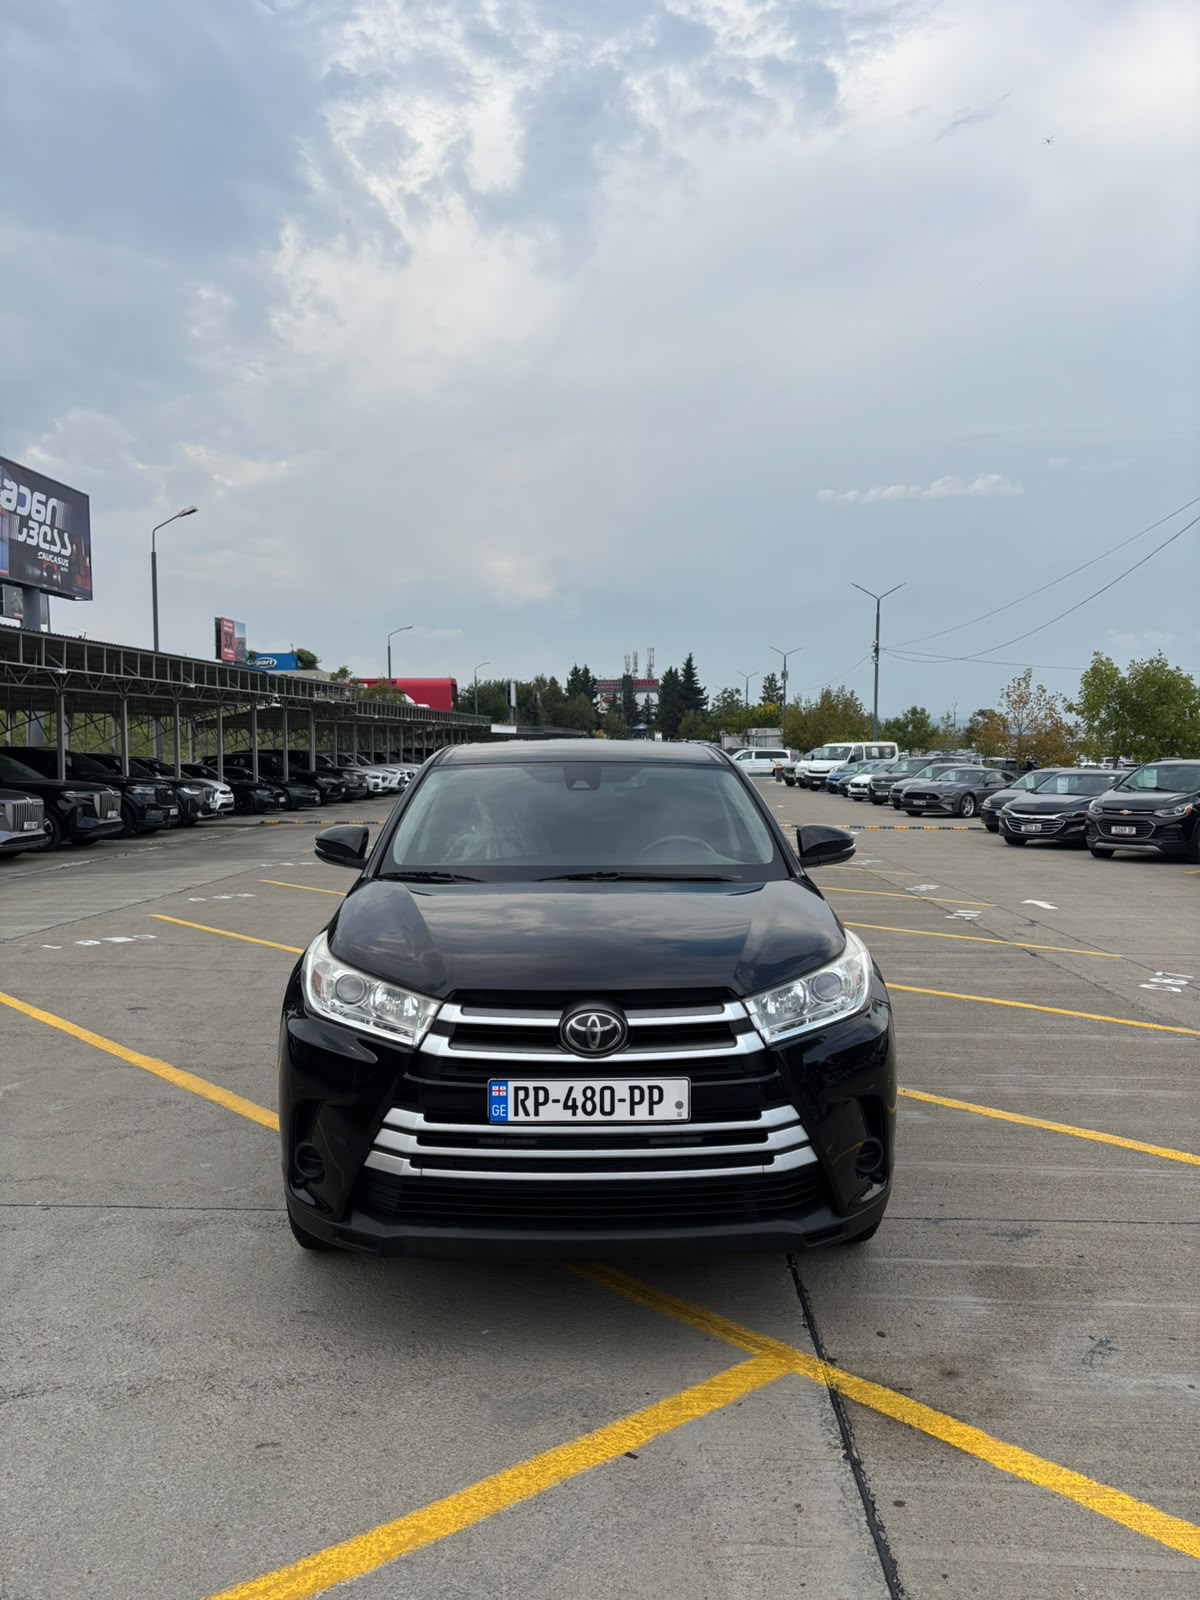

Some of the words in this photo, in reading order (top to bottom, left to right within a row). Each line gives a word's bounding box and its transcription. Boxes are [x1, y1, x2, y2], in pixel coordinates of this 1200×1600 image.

[37, 551, 69, 566] CAUCASUS
[513, 1084, 664, 1117] RP-480-PP
[491, 1104, 507, 1117] GE
